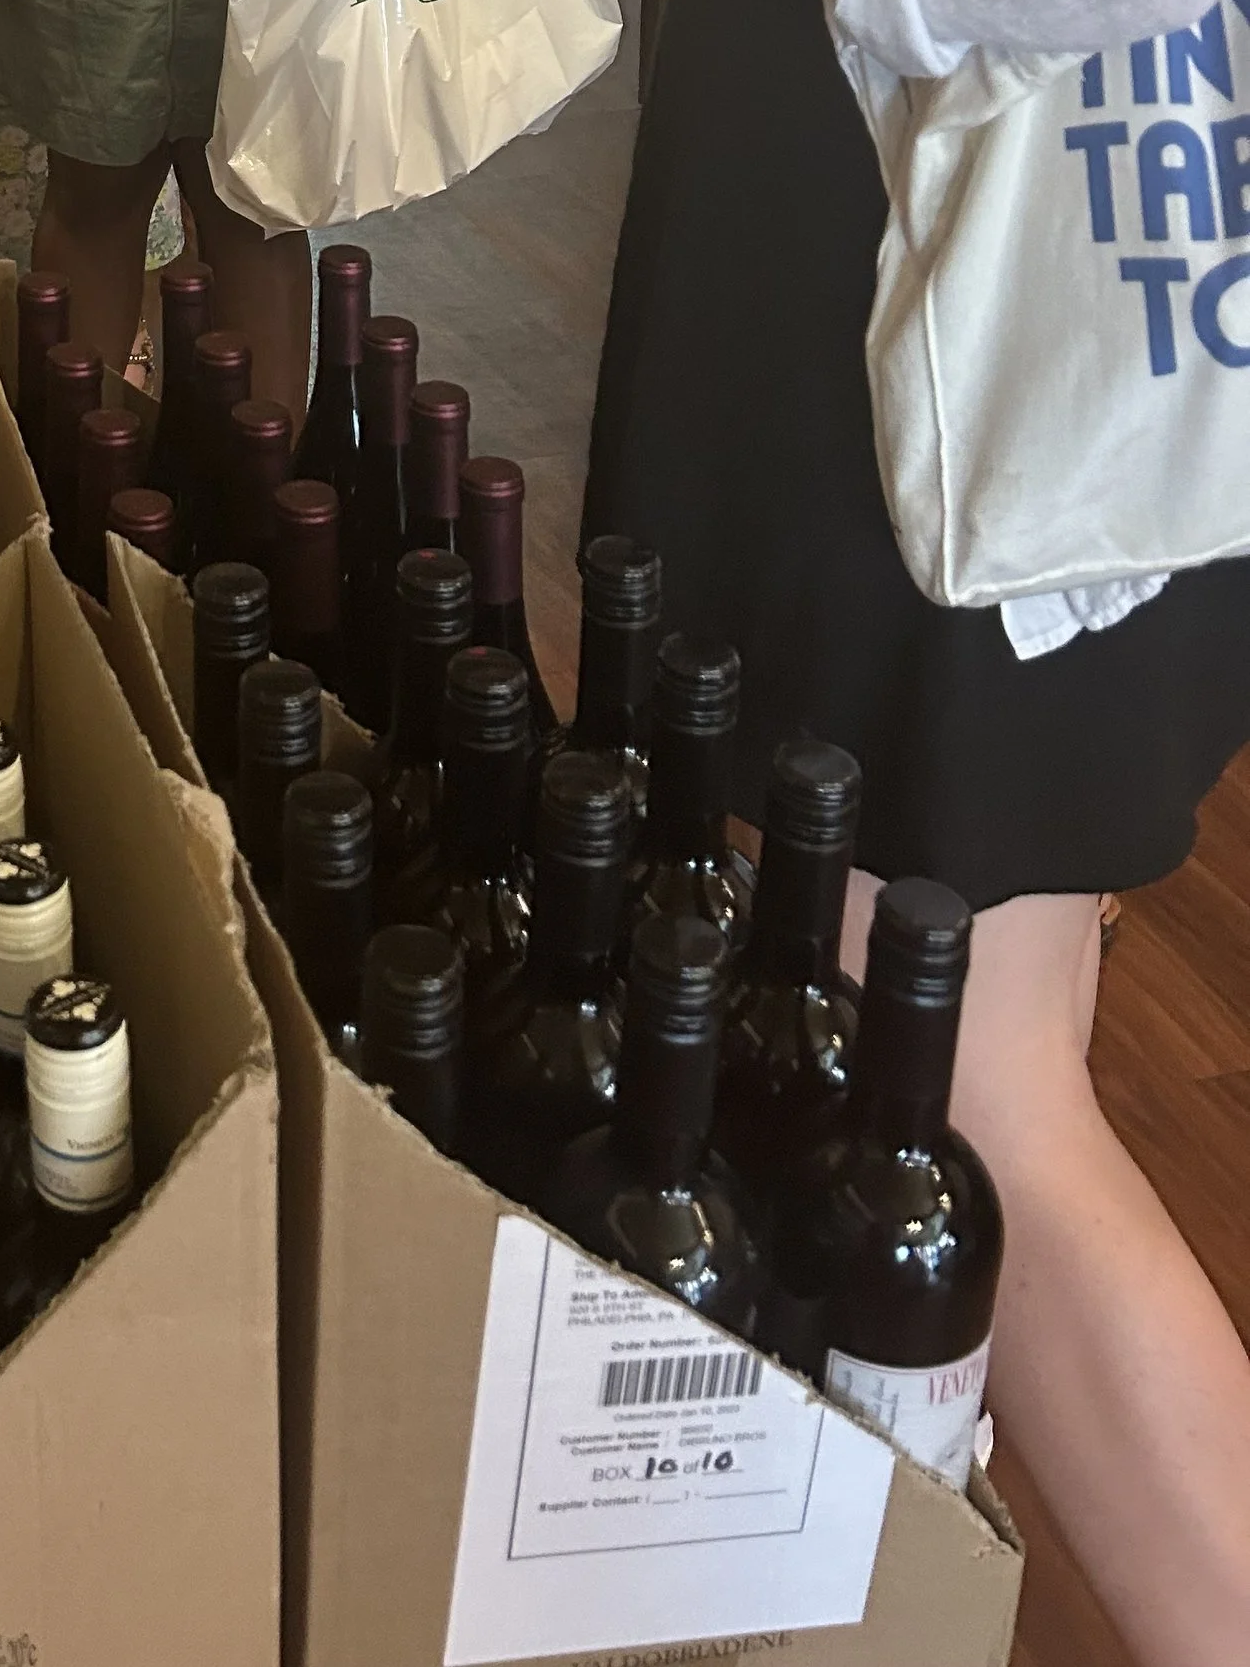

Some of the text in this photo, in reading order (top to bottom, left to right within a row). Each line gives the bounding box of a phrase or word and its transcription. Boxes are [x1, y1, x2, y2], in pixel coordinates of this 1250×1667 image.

[611, 1340, 645, 1352] Order
[560, 1429, 661, 1446] Customer Number
[571, 1444, 623, 1456] Customer
[627, 1441, 660, 1451] Name
[592, 1450, 734, 1482] BOX 10 of 10
